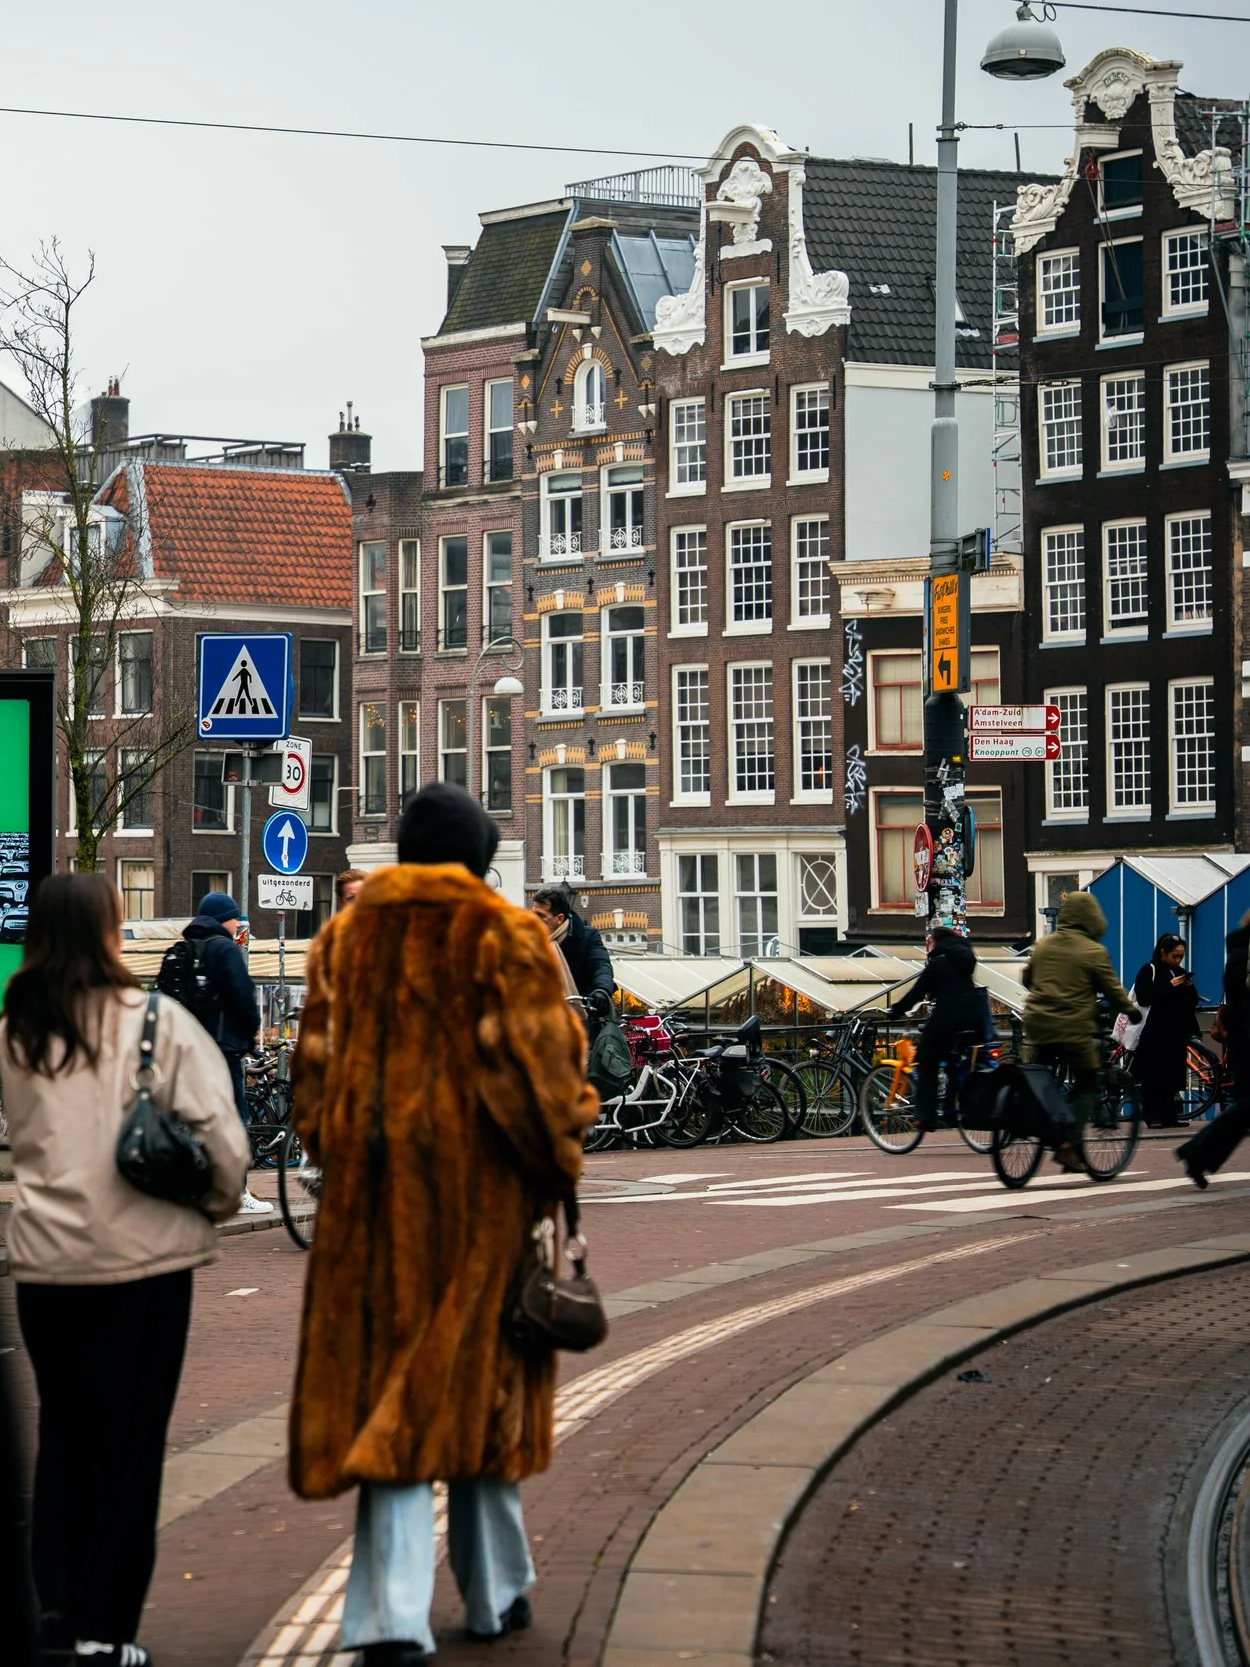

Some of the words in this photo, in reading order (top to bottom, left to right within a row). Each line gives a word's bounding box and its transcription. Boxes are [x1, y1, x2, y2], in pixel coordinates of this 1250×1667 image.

[974, 719, 1023, 727] Amstelveen
[286, 741, 302, 750] ZONE
[993, 738, 1014, 747] Haag
[974, 749, 1019, 758] Knooppunt
[286, 765, 301, 781] 30
[262, 879, 311, 888] uitgezonderd
